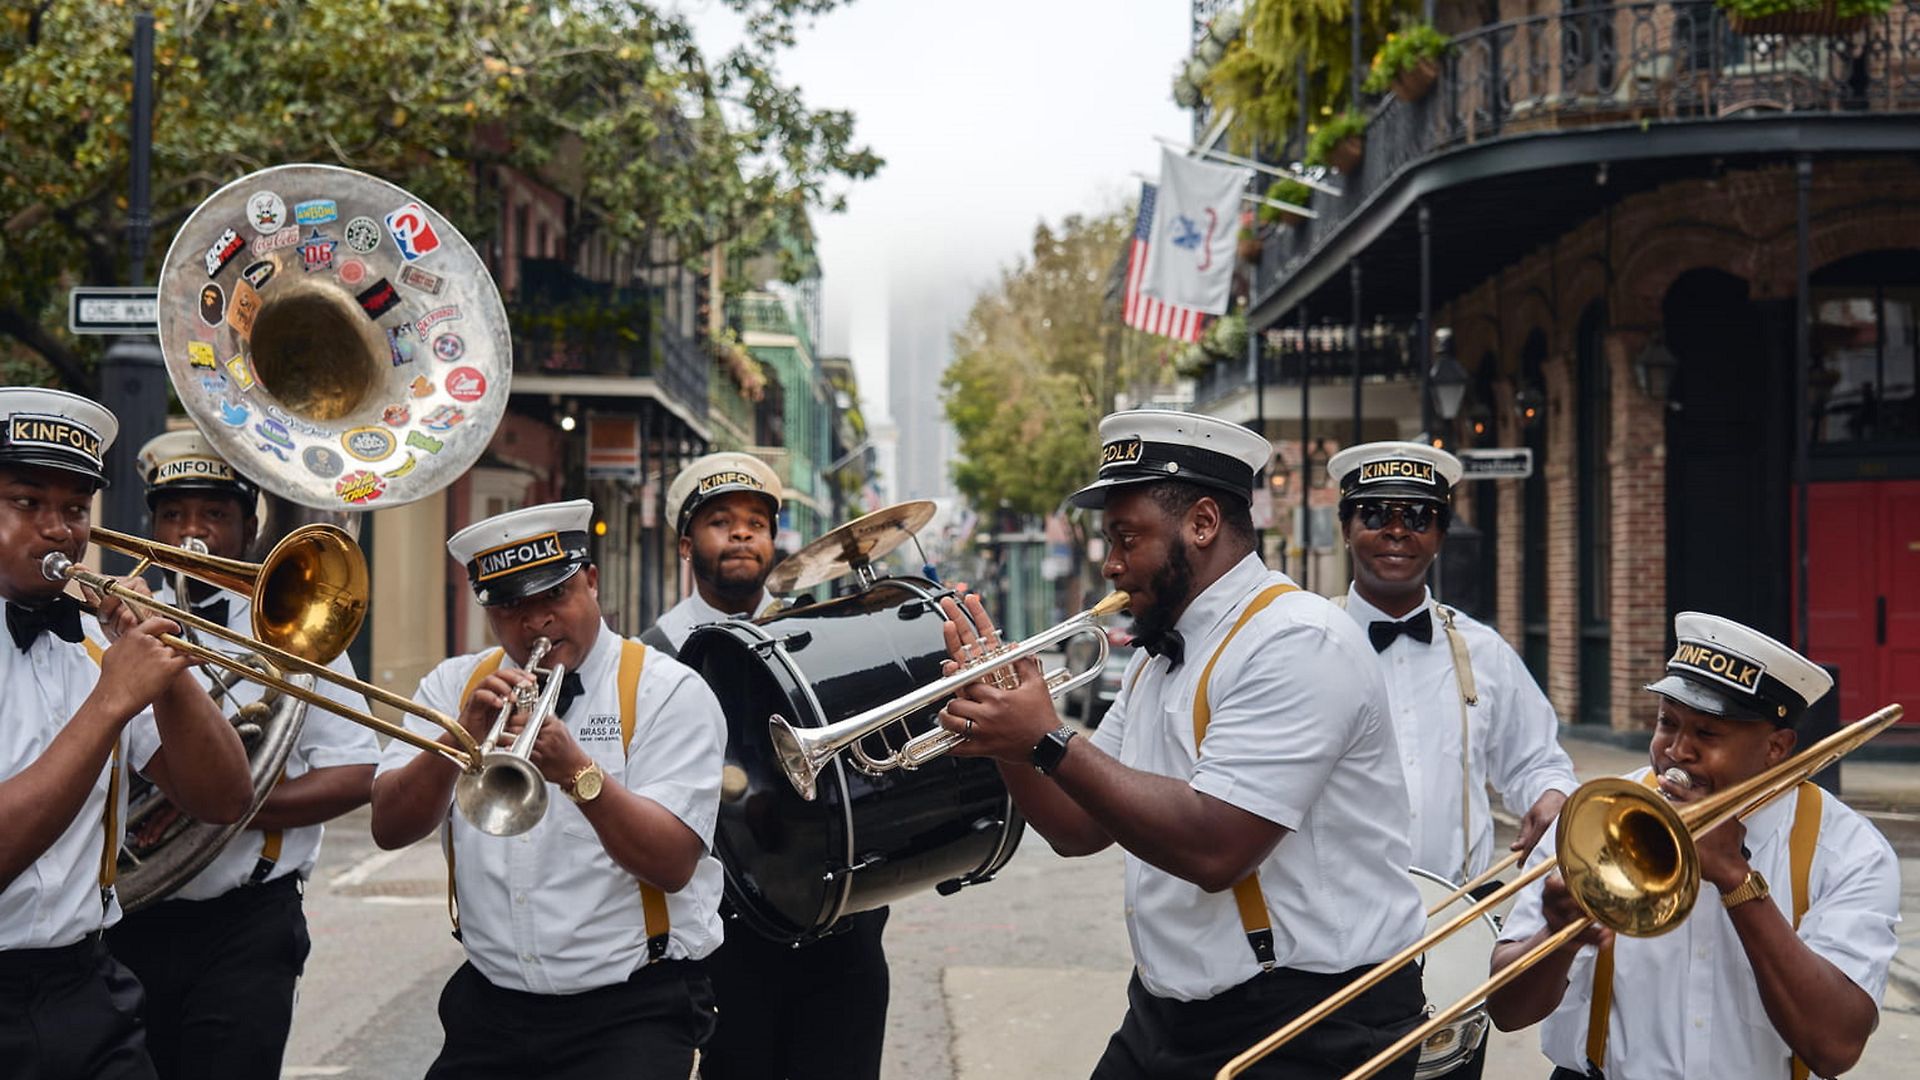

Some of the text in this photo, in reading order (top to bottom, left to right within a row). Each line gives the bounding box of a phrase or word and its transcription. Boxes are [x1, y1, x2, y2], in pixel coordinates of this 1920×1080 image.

[88, 300, 155, 321] ONE WAY
[15, 422, 100, 458] KINFOLK
[161, 461, 229, 478] KINFOLK
[1363, 462, 1432, 478] KINFOLK
[482, 538, 558, 575] KINFOLK
[1674, 644, 1757, 686] KINFOLK
[591, 717, 621, 725] KINFOL
[580, 728, 621, 736] BRASS BA
